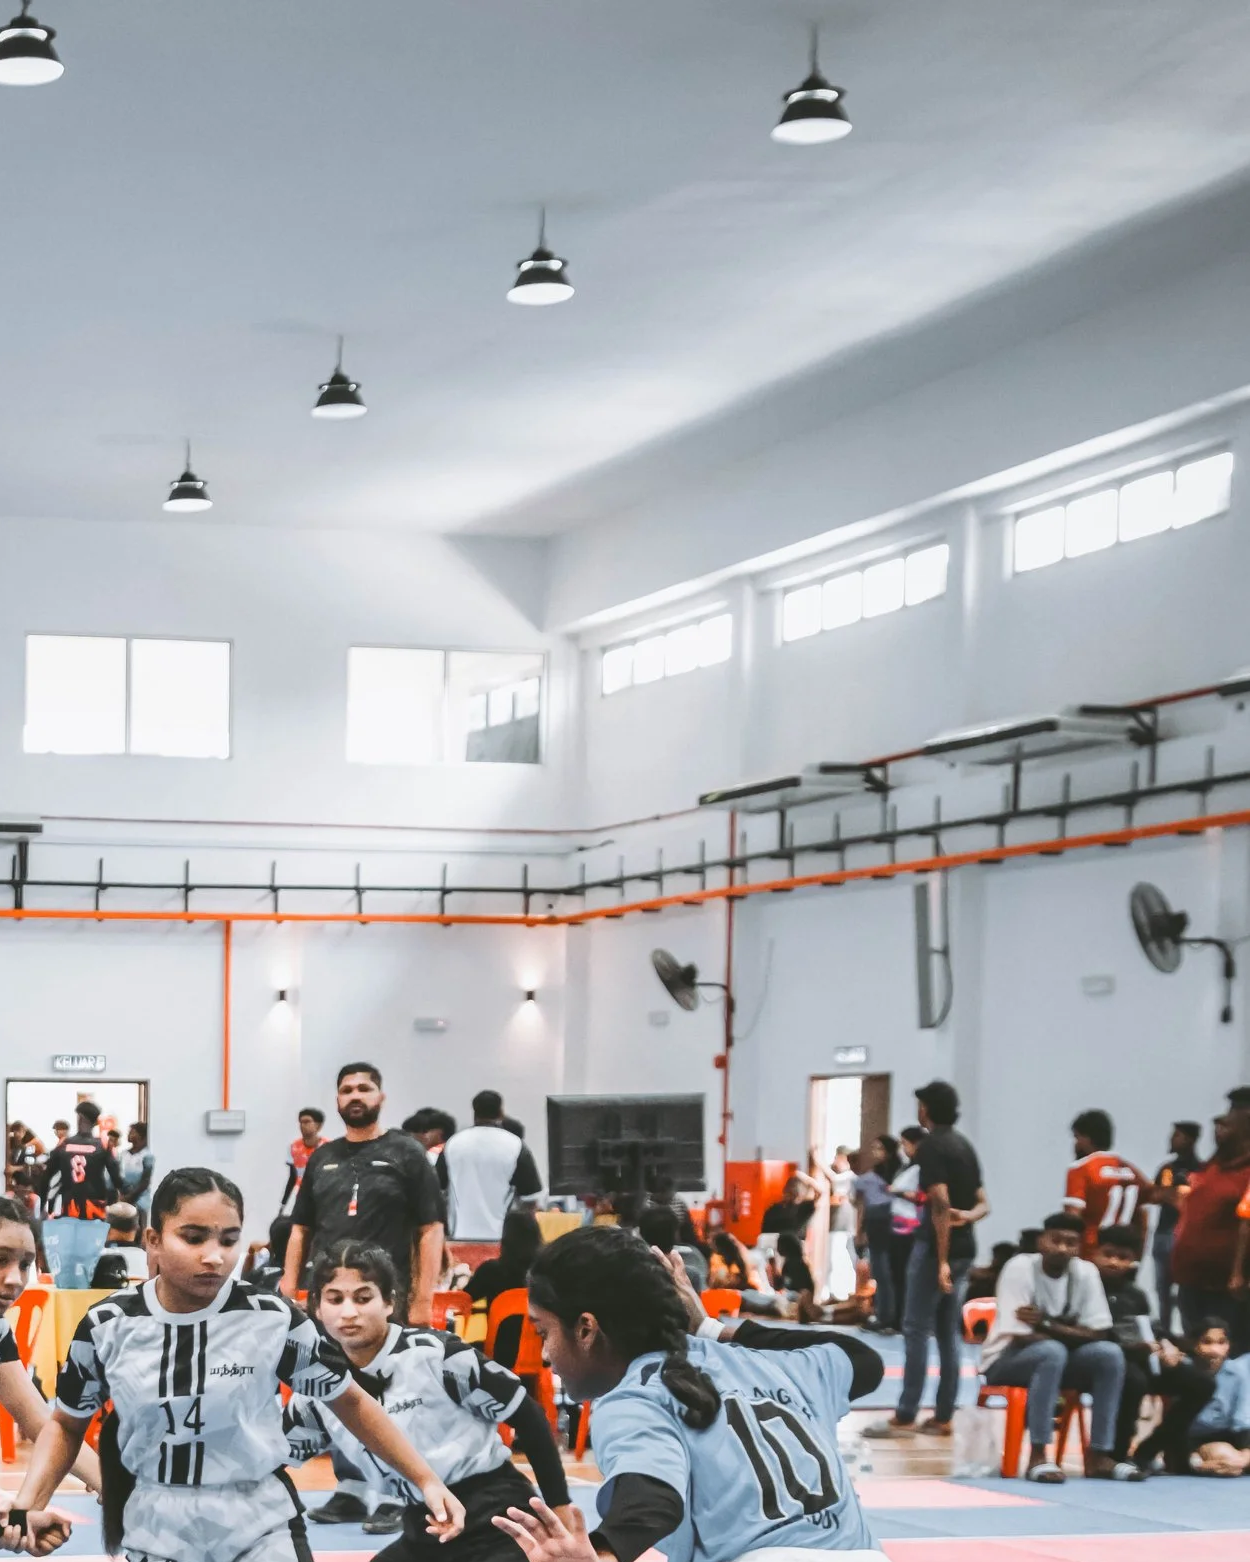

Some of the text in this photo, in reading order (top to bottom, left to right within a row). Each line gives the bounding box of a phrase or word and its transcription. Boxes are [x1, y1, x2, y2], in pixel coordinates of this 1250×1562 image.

[54, 1055, 96, 1070] KELUAR
[158, 1397, 206, 1435] 14
[722, 1394, 843, 1521] 10
